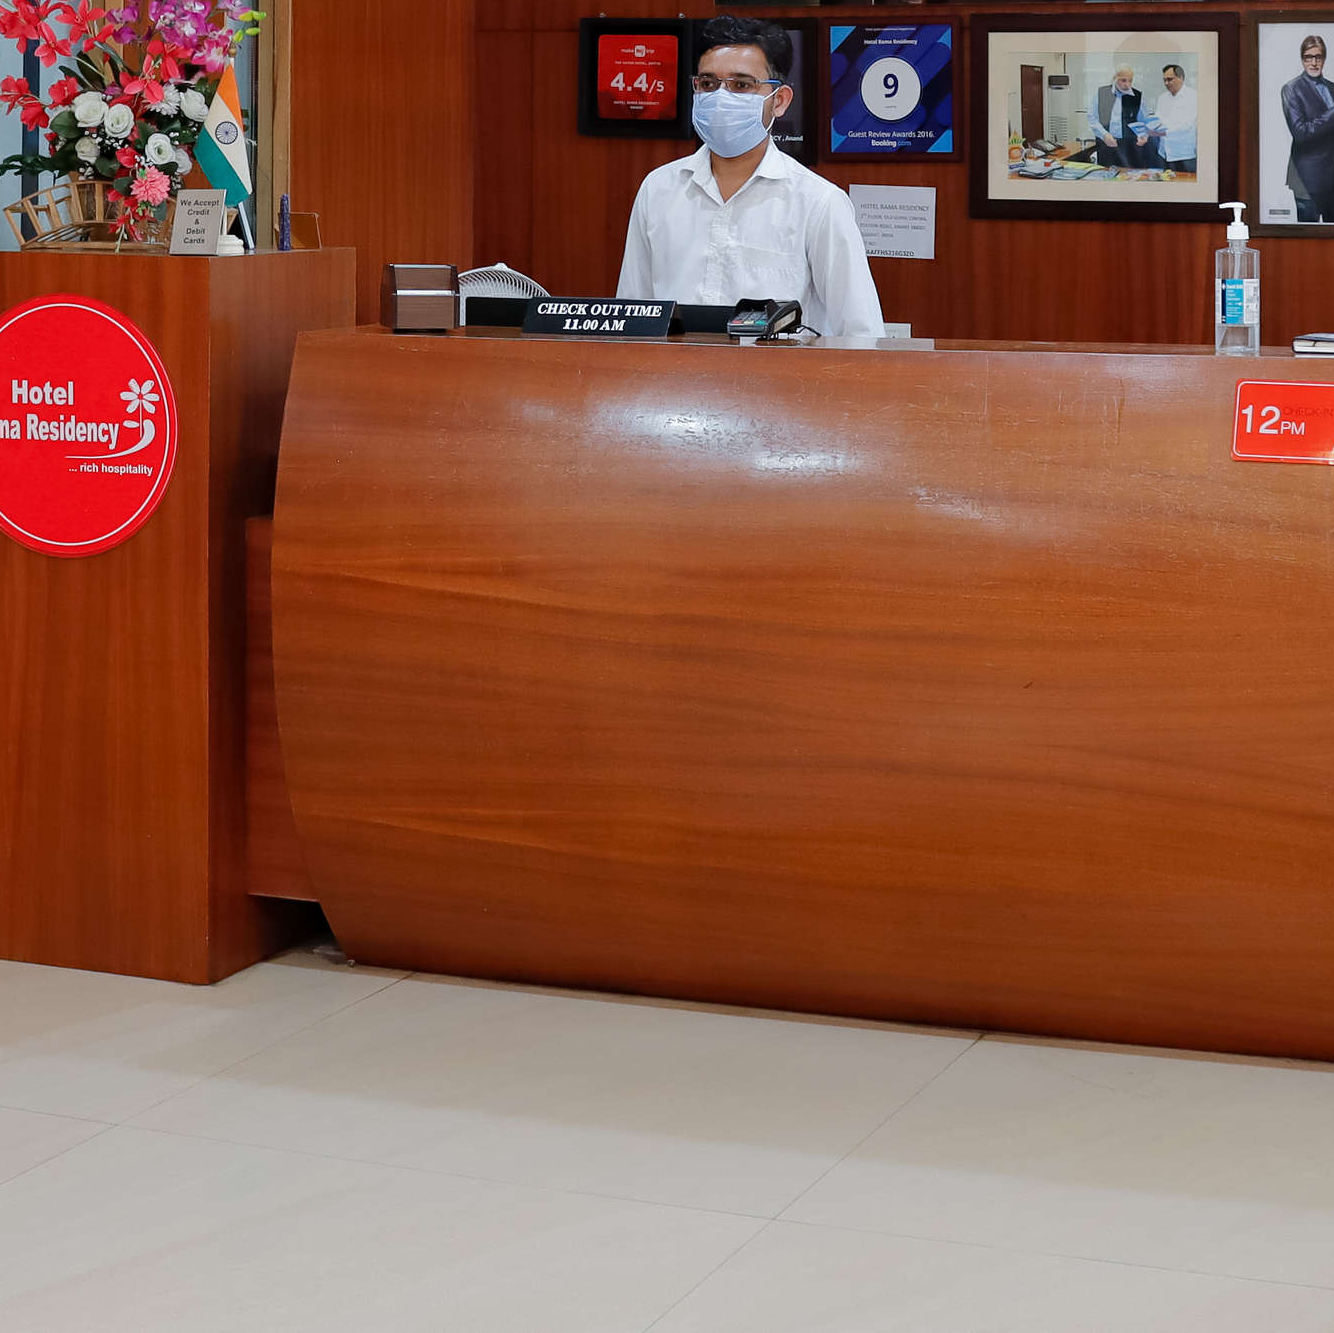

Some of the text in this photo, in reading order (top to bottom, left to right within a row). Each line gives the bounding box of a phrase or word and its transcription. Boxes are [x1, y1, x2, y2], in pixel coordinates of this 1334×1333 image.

[883, 73, 899, 99] 9
[848, 130, 867, 138] Guest
[868, 130, 890, 138] Review
[892, 130, 915, 138] Awards
[193, 199, 220, 207] Accept
[186, 227, 205, 235] Debit
[537, 303, 662, 317] CHECK OUT TIME
[562, 319, 626, 331] 11.00 AM
[11, 379, 74, 406] Hotel
[26, 413, 119, 450] Residency
[79, 463, 99, 473] rich
[101, 464, 153, 477] hospitality
